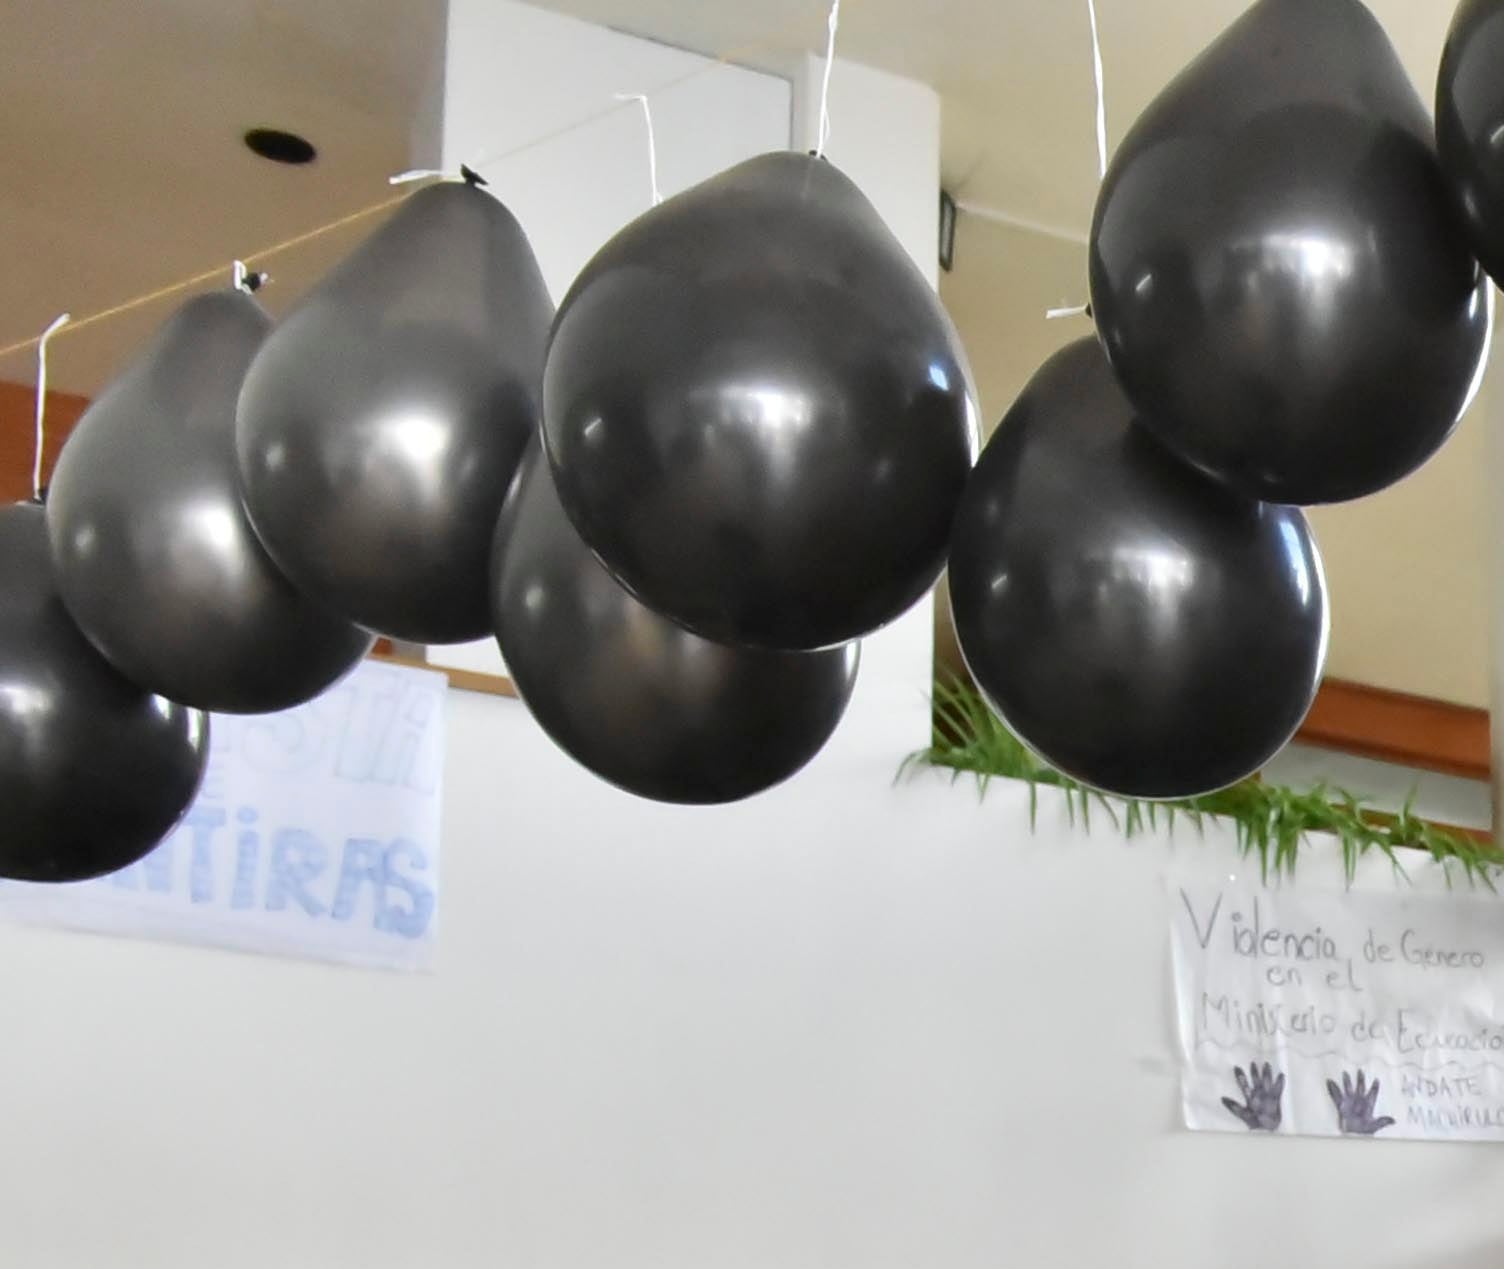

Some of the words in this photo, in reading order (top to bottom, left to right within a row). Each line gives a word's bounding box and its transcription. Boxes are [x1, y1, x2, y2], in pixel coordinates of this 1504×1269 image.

[1363, 928, 1396, 964] de
[1266, 965, 1303, 987] en
[1325, 957, 1364, 992] el
